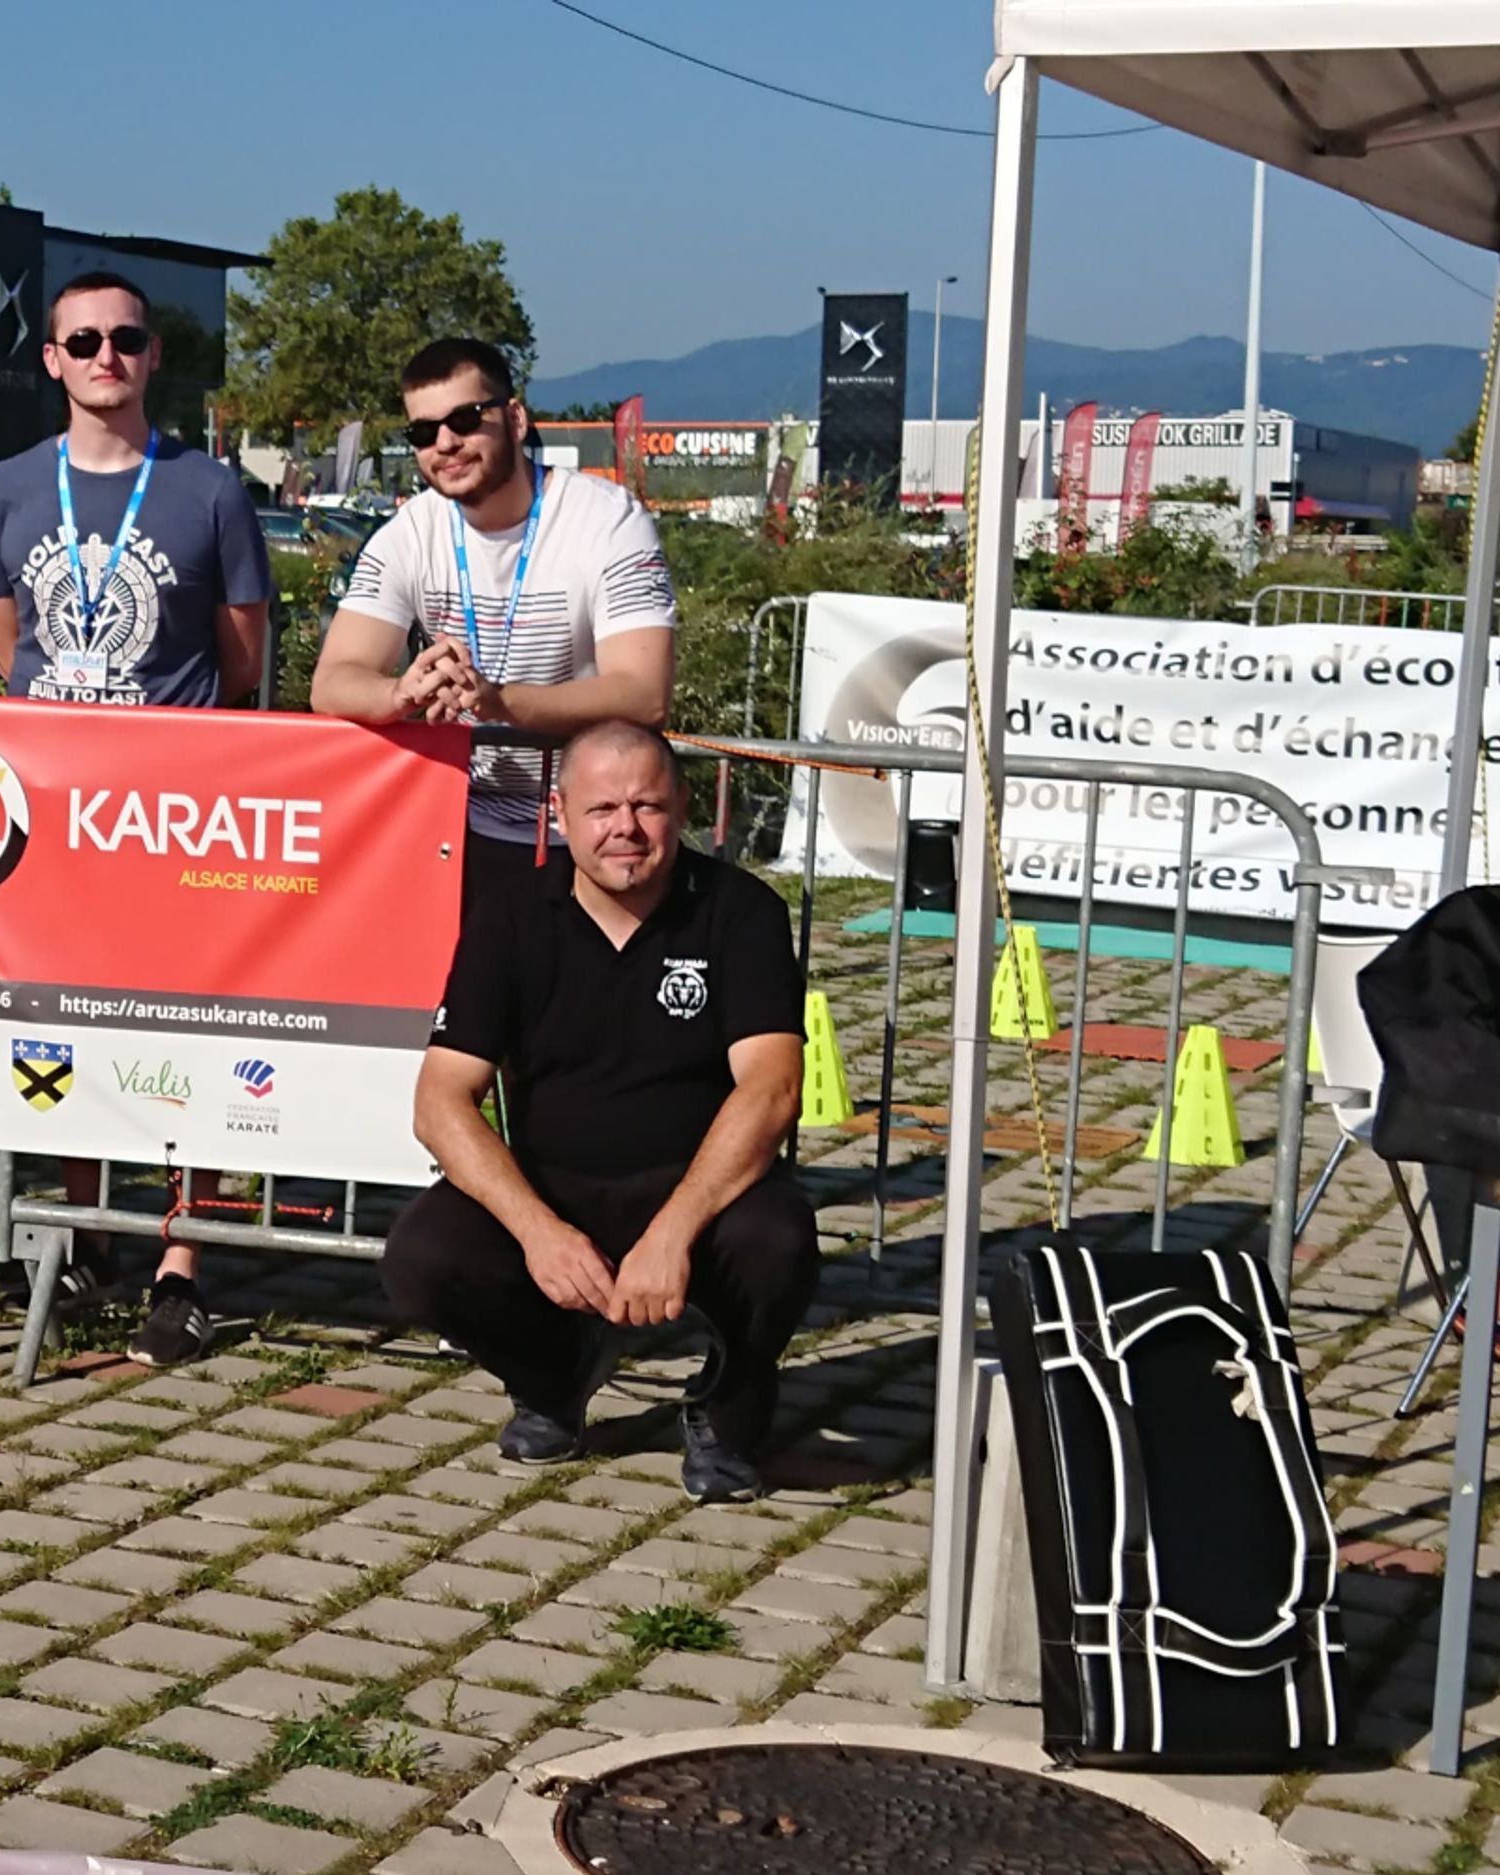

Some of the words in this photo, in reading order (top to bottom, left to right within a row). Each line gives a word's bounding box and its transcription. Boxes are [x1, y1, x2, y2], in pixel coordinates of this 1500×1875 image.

[1092, 424, 1130, 446] SUS
[1155, 424, 1187, 446] OK
[1189, 424, 1276, 446] GRILLDE
[1008, 630, 1294, 683] Association
[1311, 642, 1500, 687] d'éco
[29, 682, 68, 702] BUILT
[71, 688, 97, 704] TO
[100, 690, 148, 707] LAST
[1004, 698, 1154, 747] d'aide
[1168, 715, 1219, 752] et
[68, 788, 323, 864] KARATE
[1208, 794, 1487, 840] pesonnes
[179, 870, 248, 890] ALSACE
[253, 874, 319, 894] KARATE
[59, 993, 329, 1032] https://aruzasukarate.com
[112, 1059, 192, 1098] Vialis
[226, 1121, 280, 1135] KARATE
